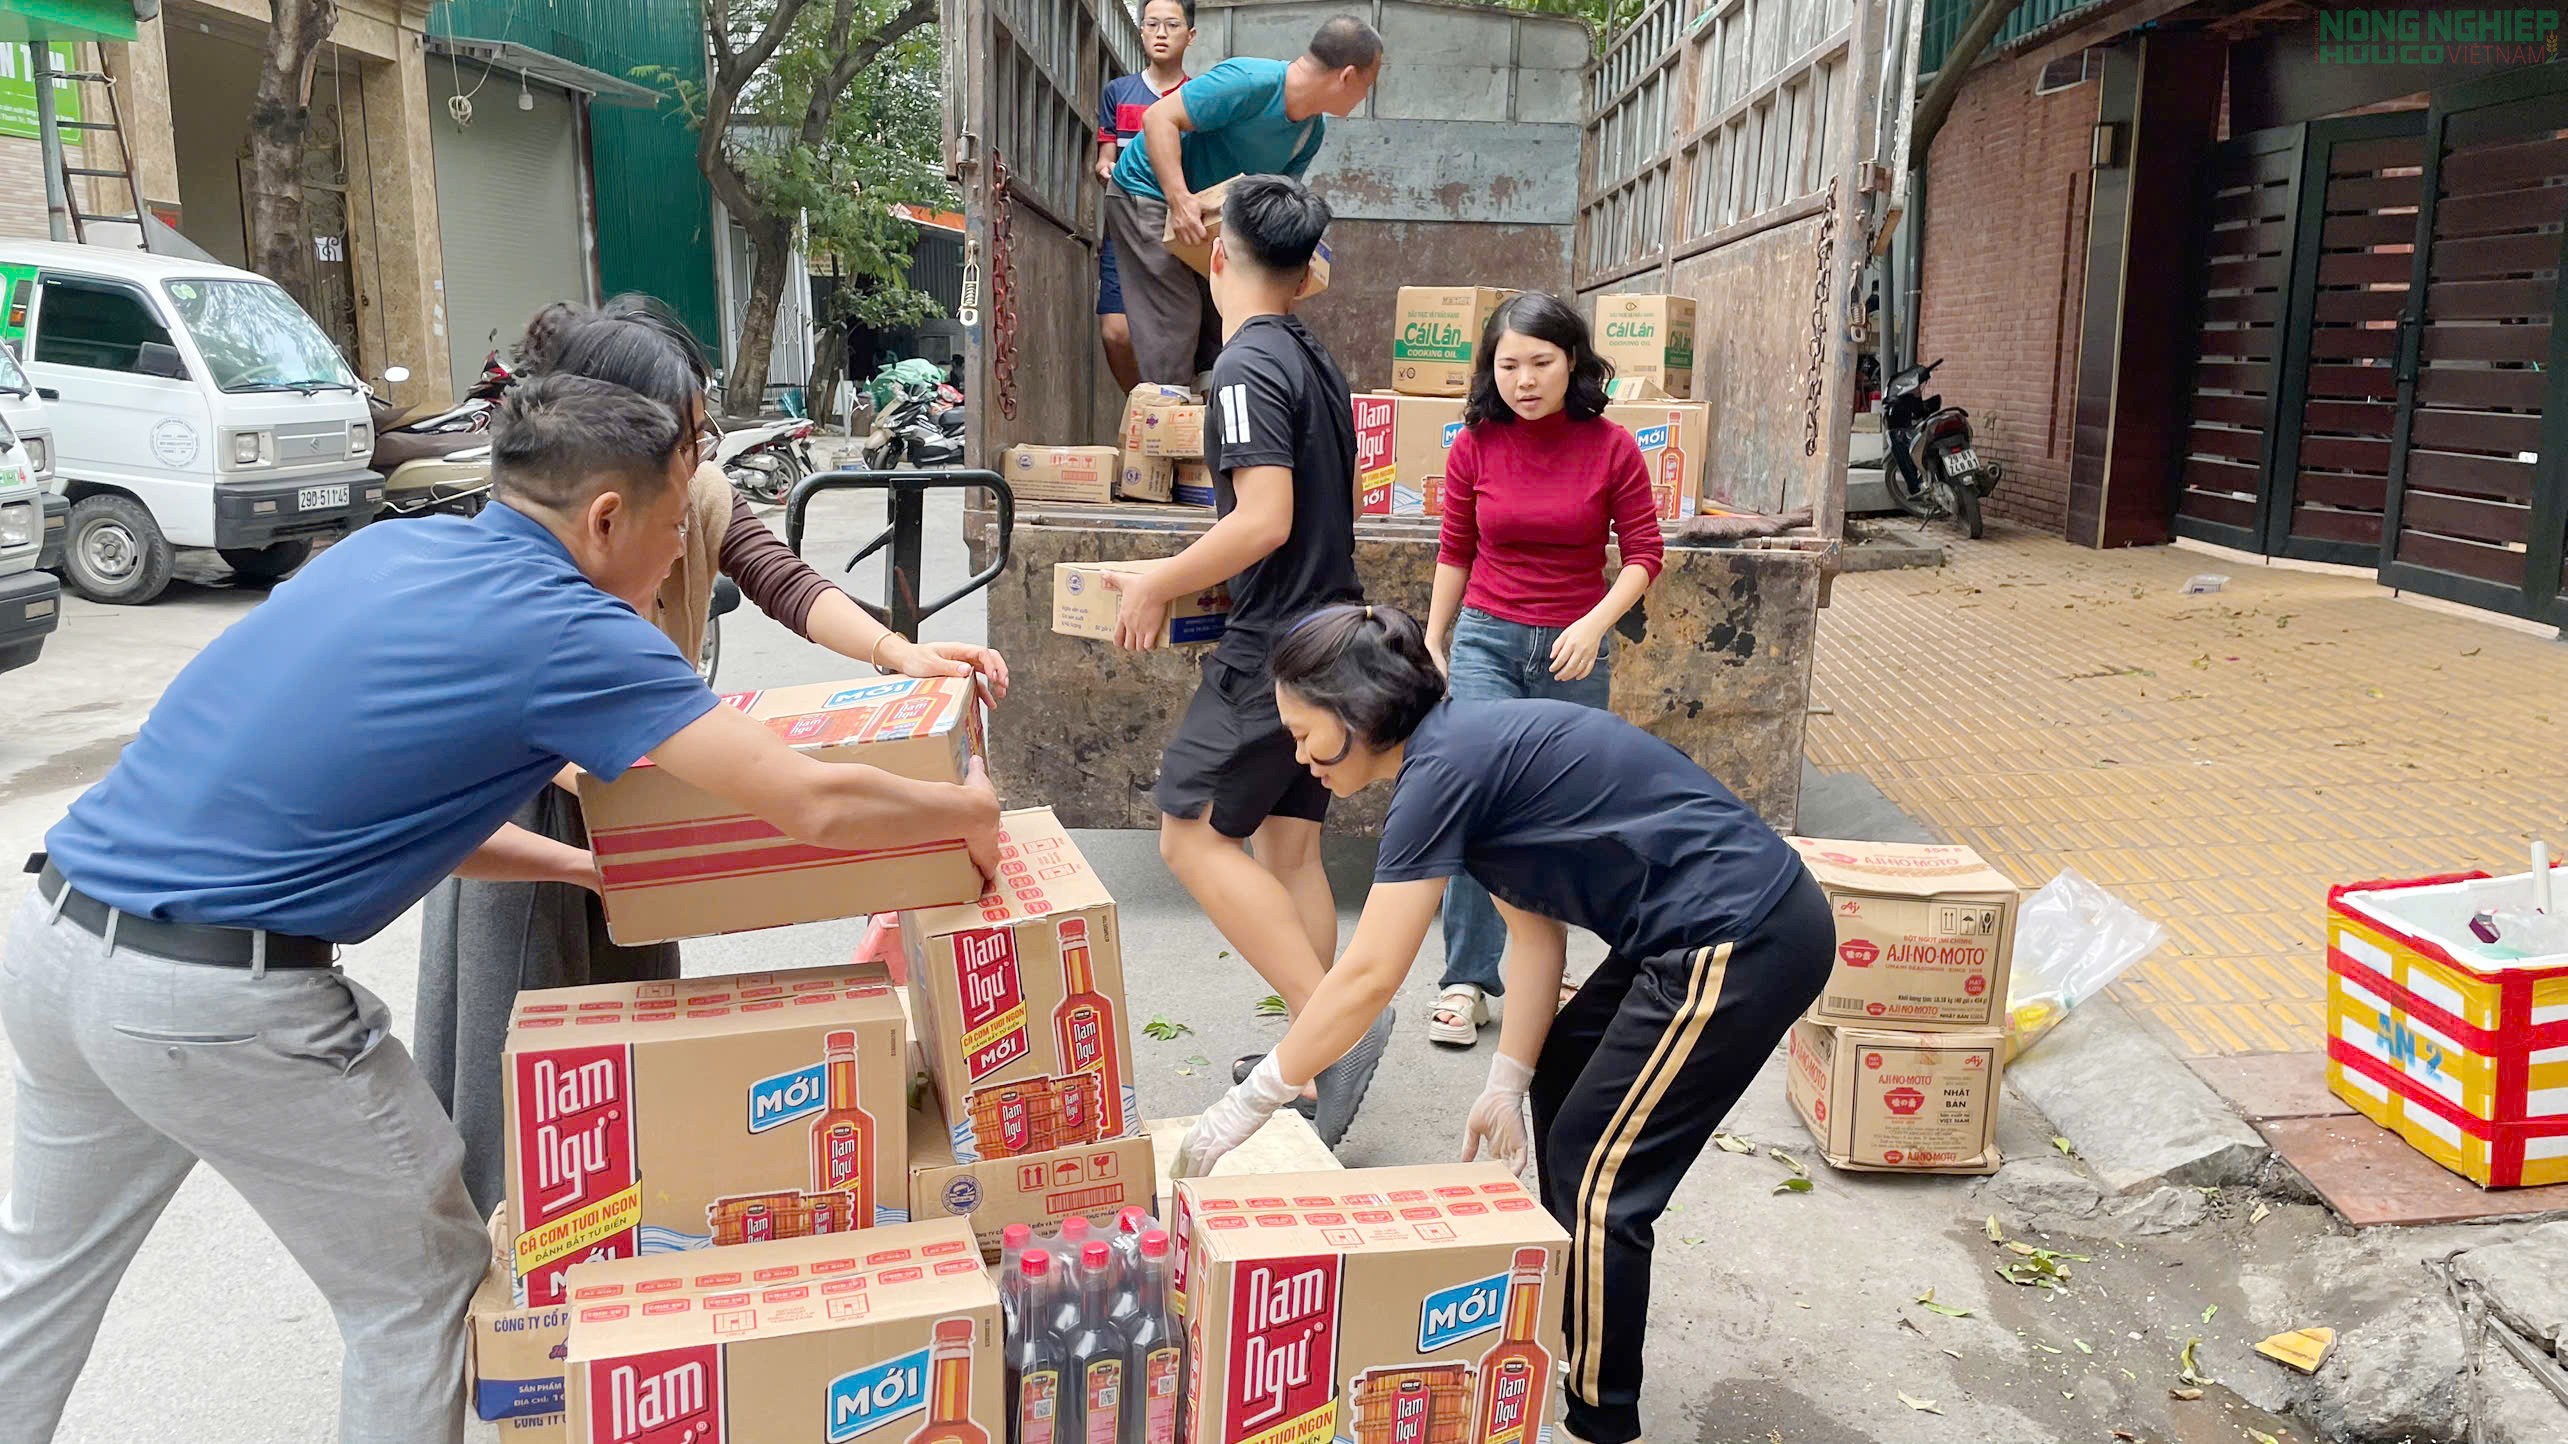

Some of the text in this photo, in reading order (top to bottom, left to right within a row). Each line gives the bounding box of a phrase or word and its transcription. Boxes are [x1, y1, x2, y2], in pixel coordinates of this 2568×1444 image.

[1407, 348, 1457, 359] COOKING OIL
[1358, 401, 1391, 430] Nam
[1637, 429, 1665, 447] MỚI
[835, 682, 907, 705] MỚI
[962, 931, 1007, 972] Nam
[966, 965, 1007, 1024] Ngư
[973, 1025, 991, 1042] CƠM
[1005, 1006, 1025, 1028] NGON
[1073, 1020, 1096, 1042] Nam
[980, 1036, 1017, 1069] MỚI
[1076, 1038, 1097, 1068] Ngư
[2376, 1011, 2444, 1084] AN 2
[534, 1057, 618, 1124] Nam
[756, 1075, 820, 1119] MỚI
[1002, 1102, 1021, 1121] Nam
[1004, 1118, 1021, 1145] Ngư
[537, 1115, 606, 1214] Ngư
[831, 1139, 855, 1159] Nam
[831, 1155, 854, 1188] Ngư
[520, 1193, 638, 1257] CÁ CƠM TƯƠI NGON
[748, 1217, 769, 1235] Nam
[814, 1211, 830, 1225] Nam
[534, 1215, 628, 1263] ĐÁNH BẮT TỪ BIỂN
[1247, 1267, 1324, 1334] Nam
[1427, 1287, 1498, 1336] MỚI
[494, 1308, 559, 1333] CÔNG TY CỔ
[519, 1381, 562, 1394] SẢN PHẨM
[1242, 1328, 1312, 1428] Ngư
[1499, 1377, 1526, 1394] Nam
[513, 1399, 529, 1408] ĐỊA
[611, 1361, 704, 1441] Nam
[836, 1367, 918, 1426] MỚI
[1397, 1397, 1424, 1420] Nam
[1298, 1410, 1334, 1437] NGON
[1494, 1400, 1521, 1433] Ngư
